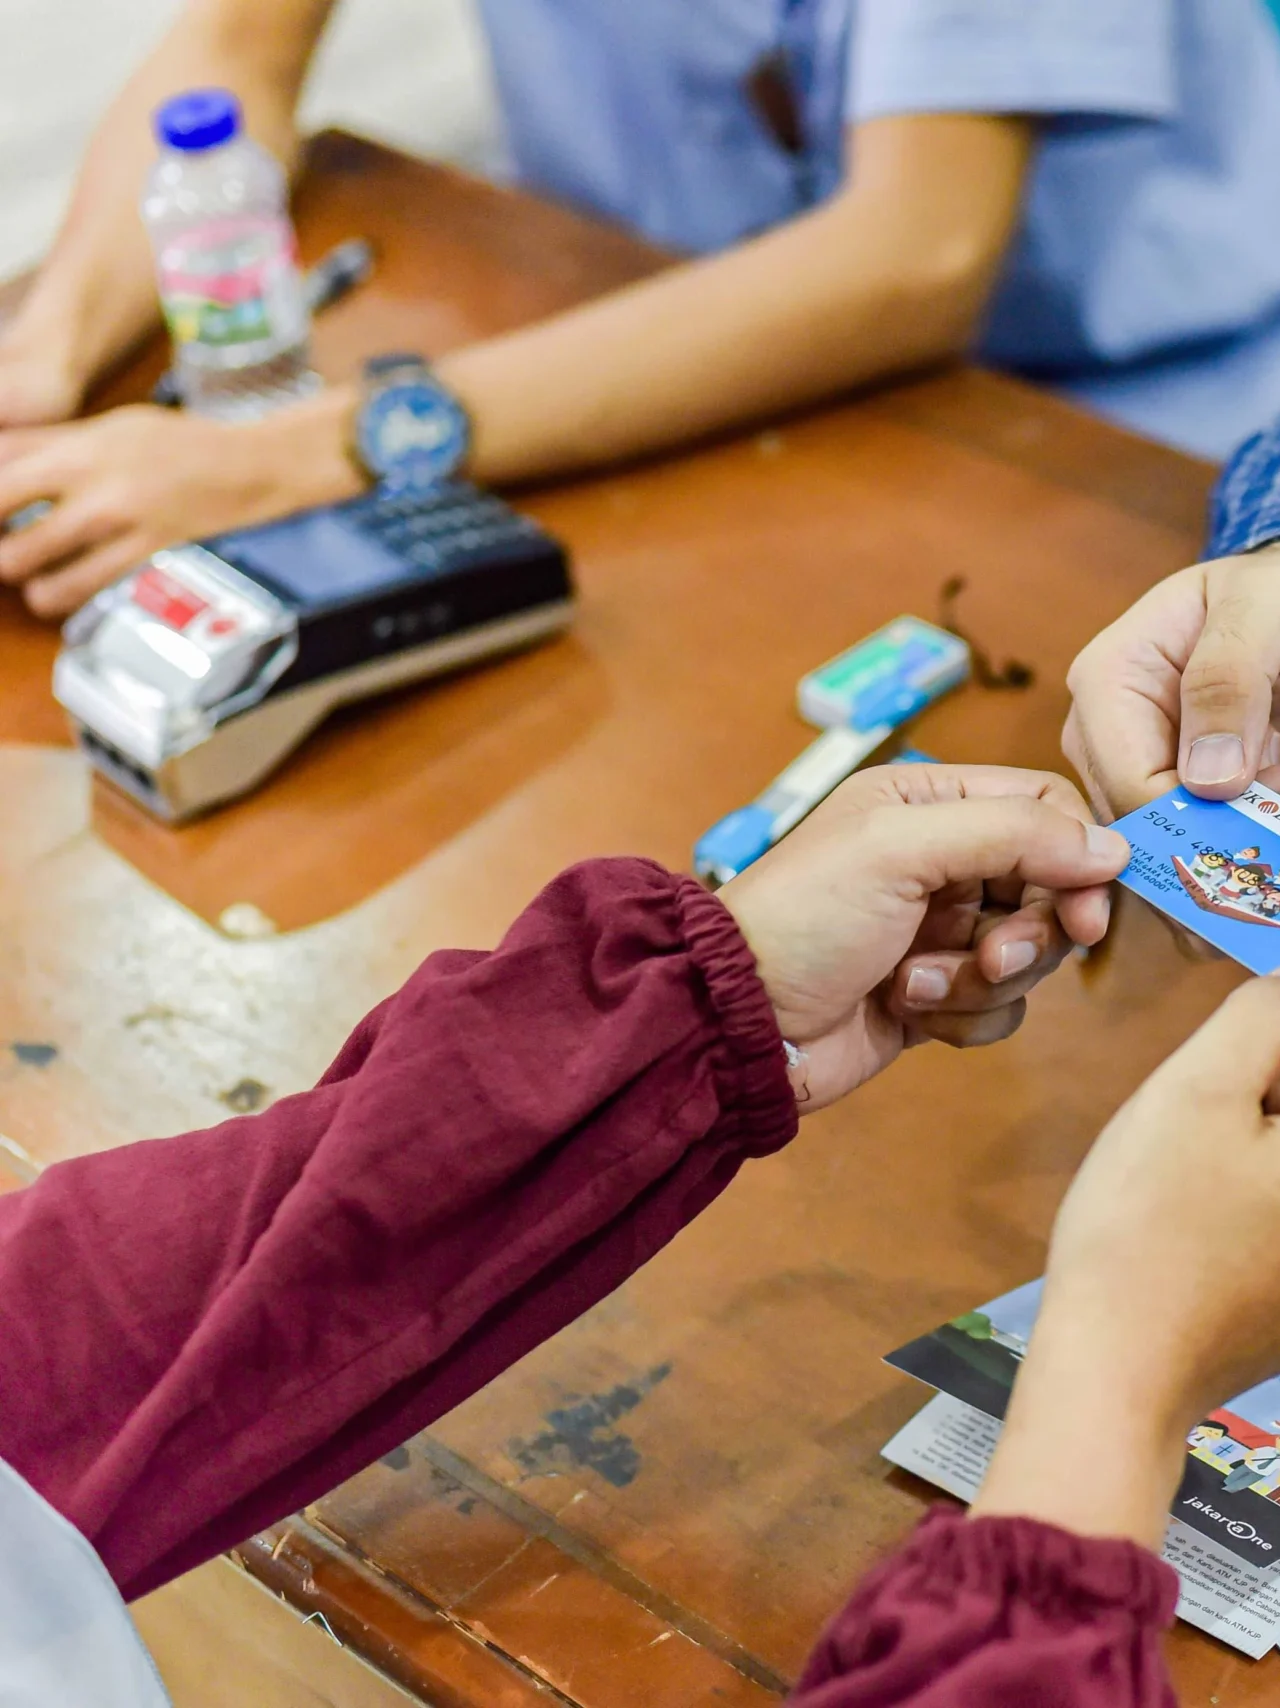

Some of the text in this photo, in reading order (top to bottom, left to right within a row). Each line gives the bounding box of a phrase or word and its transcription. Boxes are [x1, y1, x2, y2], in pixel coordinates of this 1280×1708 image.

[1143, 811, 1186, 837] 5049
[1157, 863, 1180, 879] NUR
[1215, 1569, 1232, 1579] ATM
[1233, 1578, 1248, 1587] KJP
[1230, 1621, 1248, 1632] ATM
